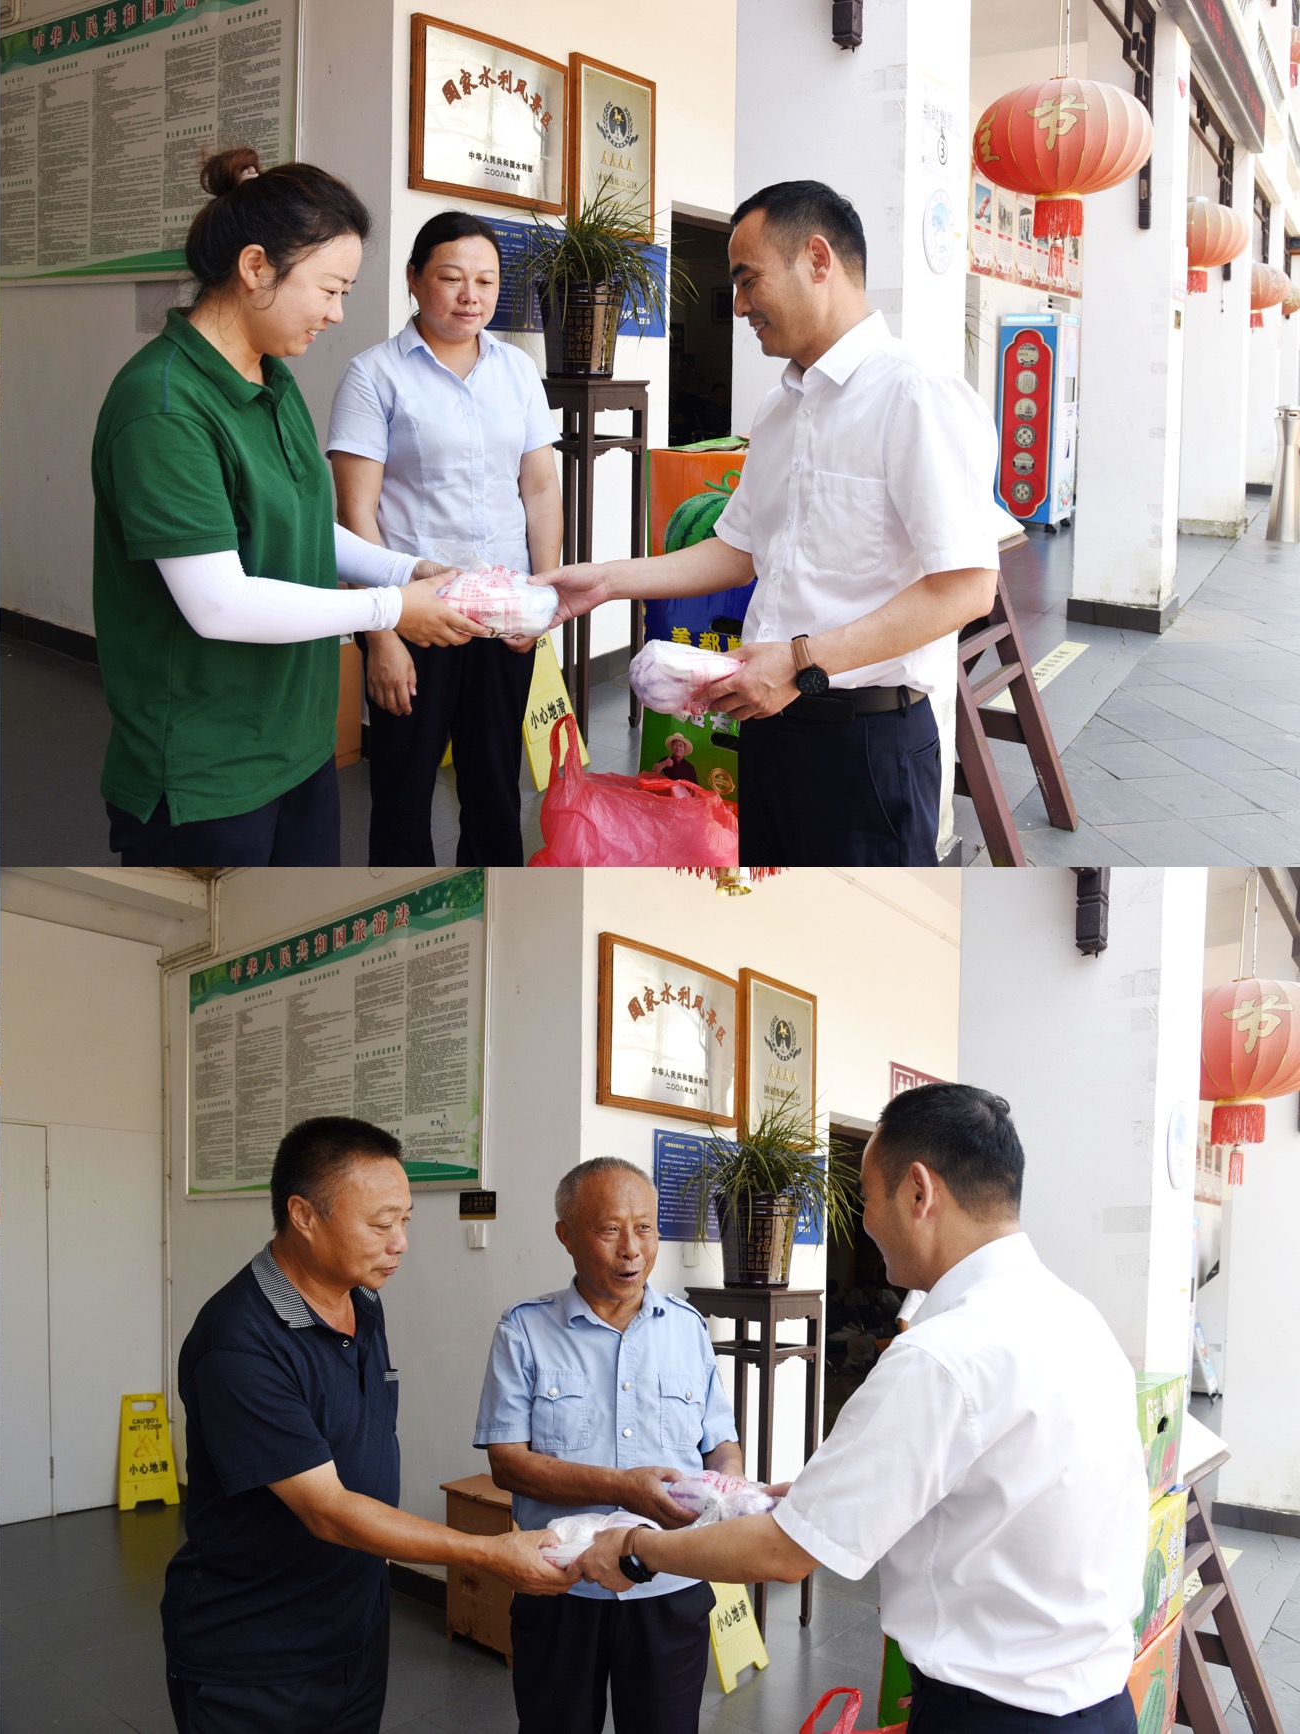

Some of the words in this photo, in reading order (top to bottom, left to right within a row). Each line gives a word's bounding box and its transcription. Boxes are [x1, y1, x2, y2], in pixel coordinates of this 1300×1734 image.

[442, 66, 553, 132] 国家水利风景区
[468, 151, 534, 174] 中华人民共和国水利部
[601, 150, 635, 173] AAAA
[530, 697, 567, 730] 小心地滑
[231, 902, 410, 985] 中华人民共和国旅游法
[628, 983, 726, 1047] 国家水利风景区
[1221, 994, 1295, 1055] 节
[651, 1066, 710, 1088] 中华人民共和国水利部
[768, 1063, 799, 1084] AAAA
[129, 1460, 169, 1475] 小心地滑
[716, 1599, 748, 1632] 小心地滑
